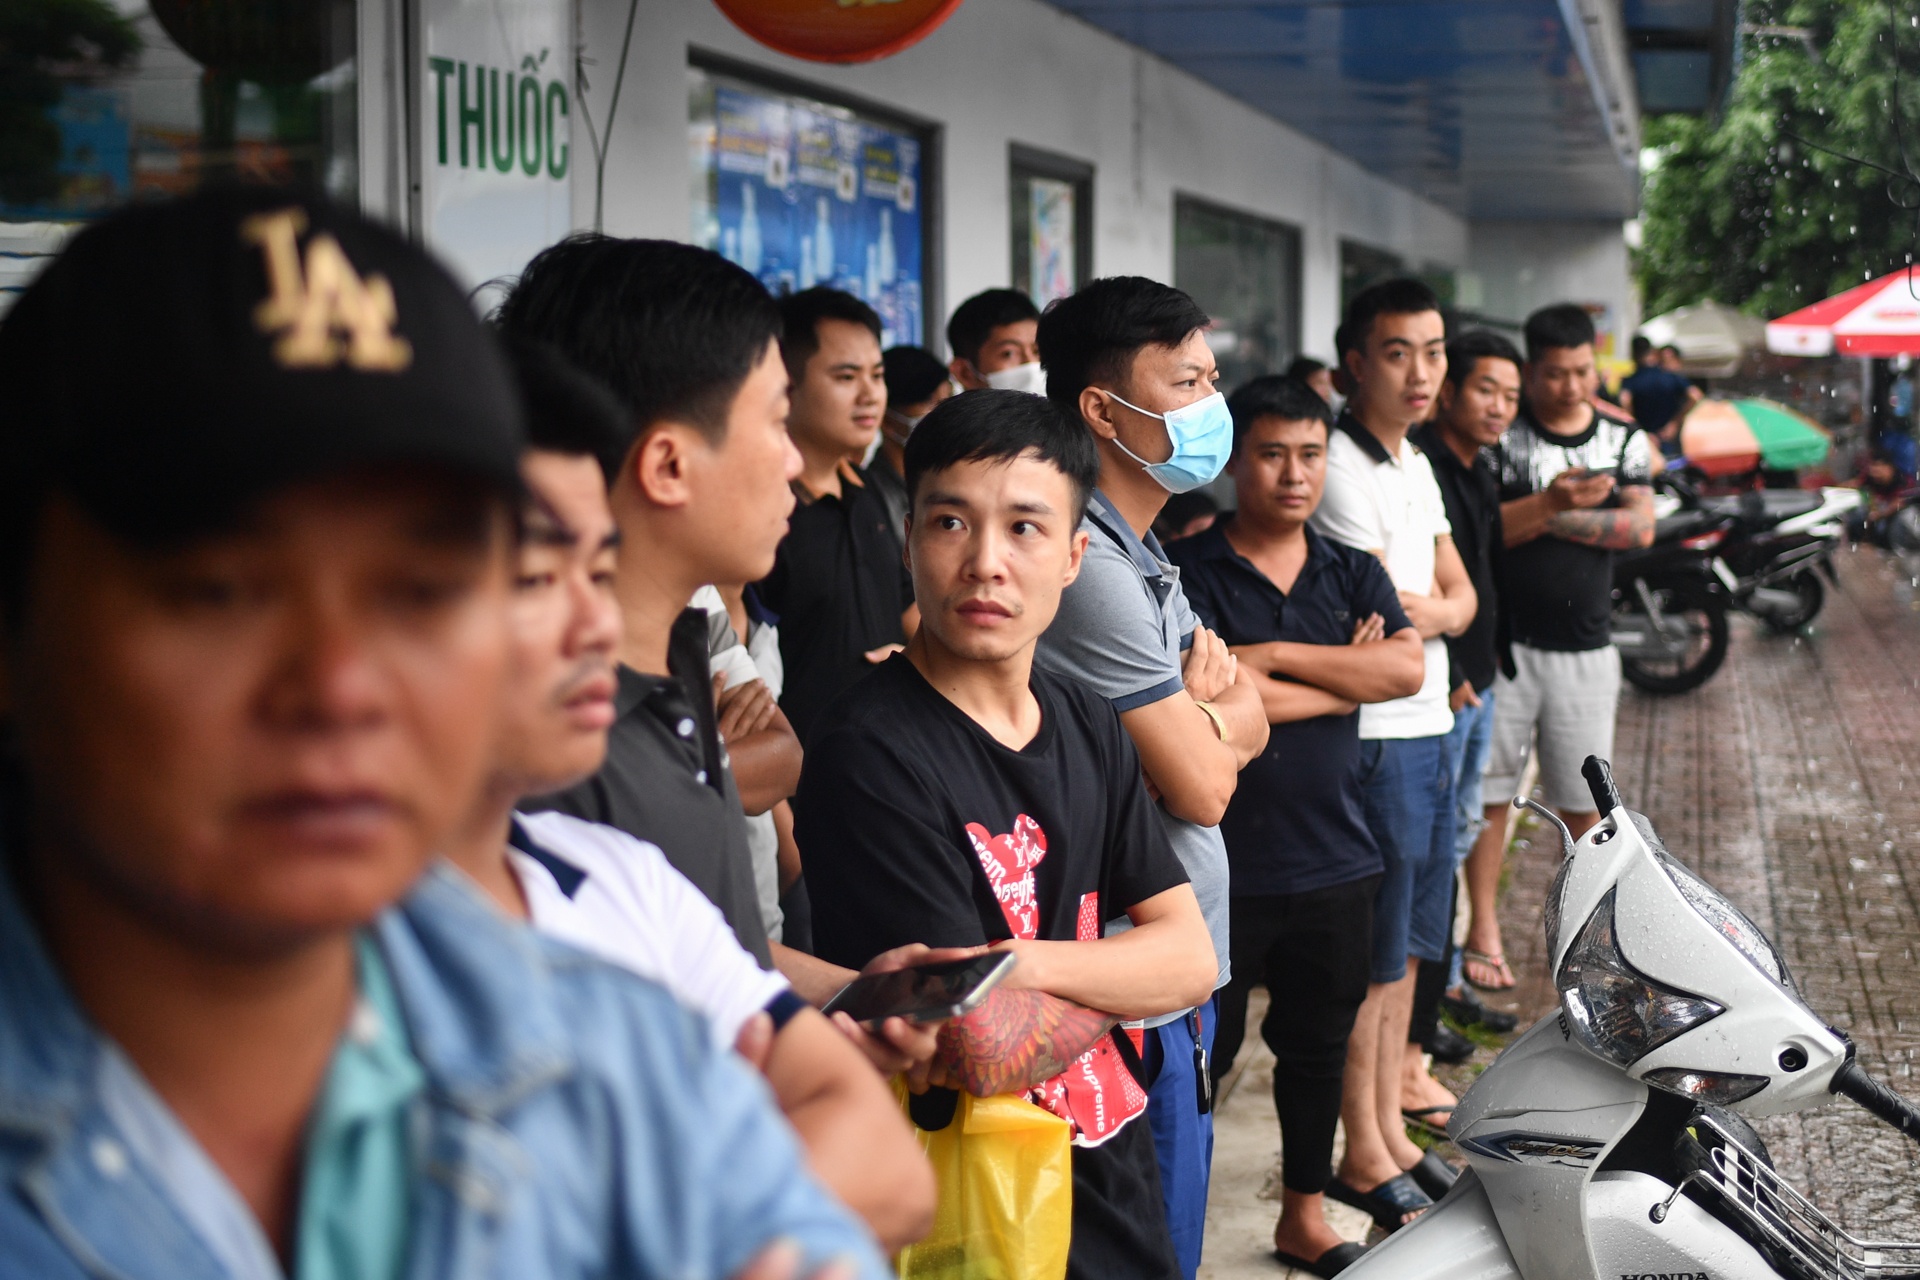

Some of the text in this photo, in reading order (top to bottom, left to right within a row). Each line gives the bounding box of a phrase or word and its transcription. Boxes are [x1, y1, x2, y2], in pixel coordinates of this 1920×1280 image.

[428, 48, 569, 181] THUỐC
[241, 207, 412, 370] LA
[1080, 1051, 1105, 1133] Supreme
